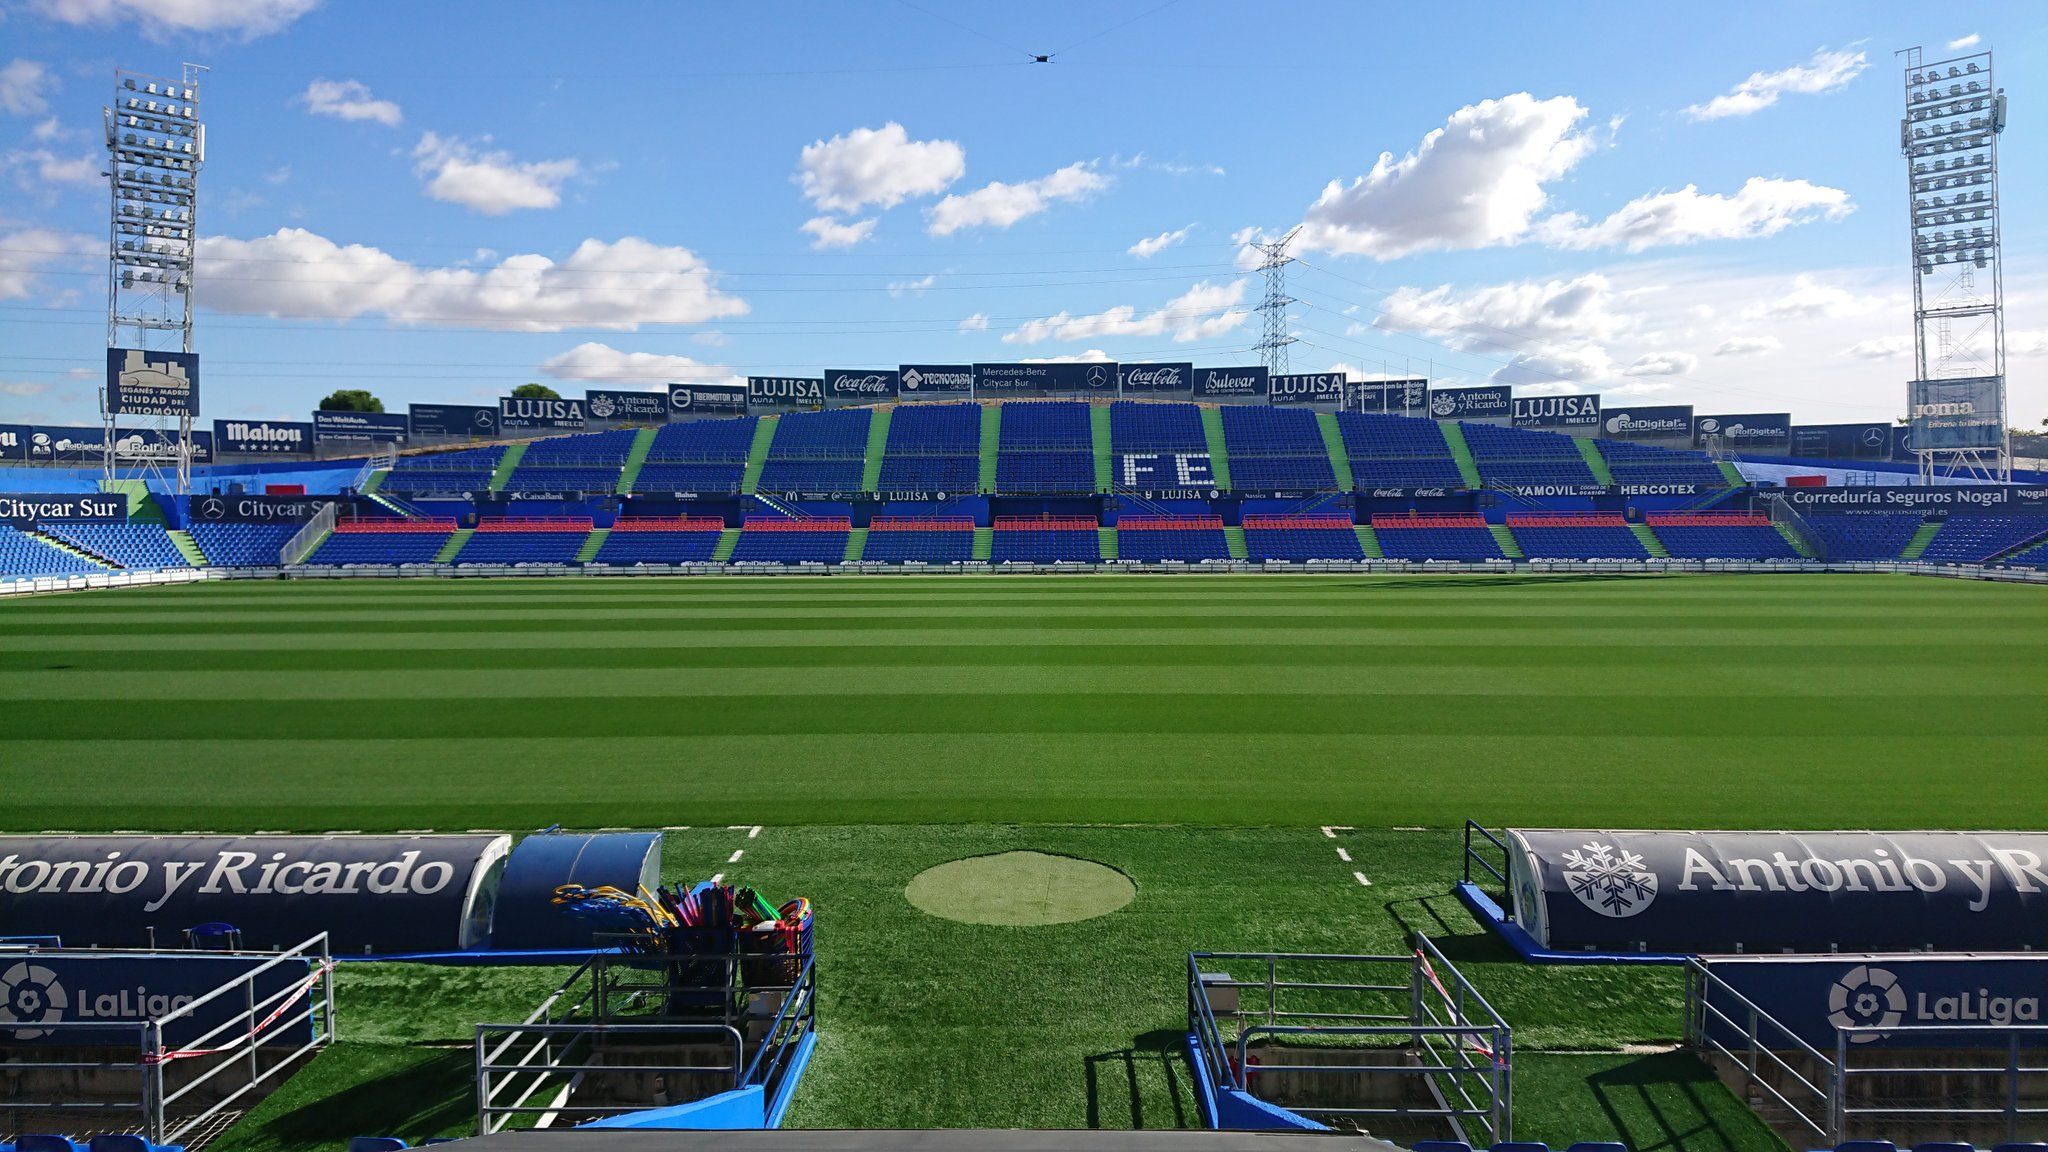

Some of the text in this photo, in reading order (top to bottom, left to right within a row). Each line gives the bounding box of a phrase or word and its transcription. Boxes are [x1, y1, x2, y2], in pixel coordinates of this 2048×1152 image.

[983, 367, 1047, 376] Mercedes-Benz
[923, 373, 971, 385] TECNOCASA
[983, 378, 1029, 388] Citycar Sur
[1205, 370, 1255, 388] Bulevar
[1270, 375, 1343, 395] LUJISA
[119, 386, 154, 396] LEGANÉS
[160, 388, 190, 397] MADRID
[750, 379, 822, 398] LUJISA
[122, 395, 185, 407] CIUDAD DEL
[617, 395, 659, 406] Antonio
[692, 391, 744, 402] TIBERMOTOR SUR
[1458, 390, 1502, 402] Antonio
[119, 403, 190, 417] AUTOMÓVIL
[502, 399, 584, 419] LUJISA
[625, 404, 664, 414] Ricardo
[1466, 399, 1507, 410] Ricardo
[1514, 397, 1597, 418] LUJISA
[318, 415, 332, 423] Das
[1928, 421, 1958, 429] Entrena
[226, 423, 302, 442] Mahou
[523, 491, 564, 500] CaixaBank
[889, 492, 929, 500] LUJISA
[1161, 490, 1201, 499] LUJISA
[1516, 486, 1577, 496] YAMOVIL
[1620, 485, 1695, 495] HERCOTEX
[1793, 489, 2008, 506] Correduría Seguros Nogal
[0, 499, 117, 521] Citycar Sur
[238, 500, 305, 520] Citycar
[144, 862, 206, 912] y
[198, 850, 455, 895] Ricardo
[1677, 847, 1947, 892] Antonio
[1947, 858, 1995, 912] y
[78, 985, 194, 1020] LaLiga
[1917, 986, 2038, 1027] LaLiga
